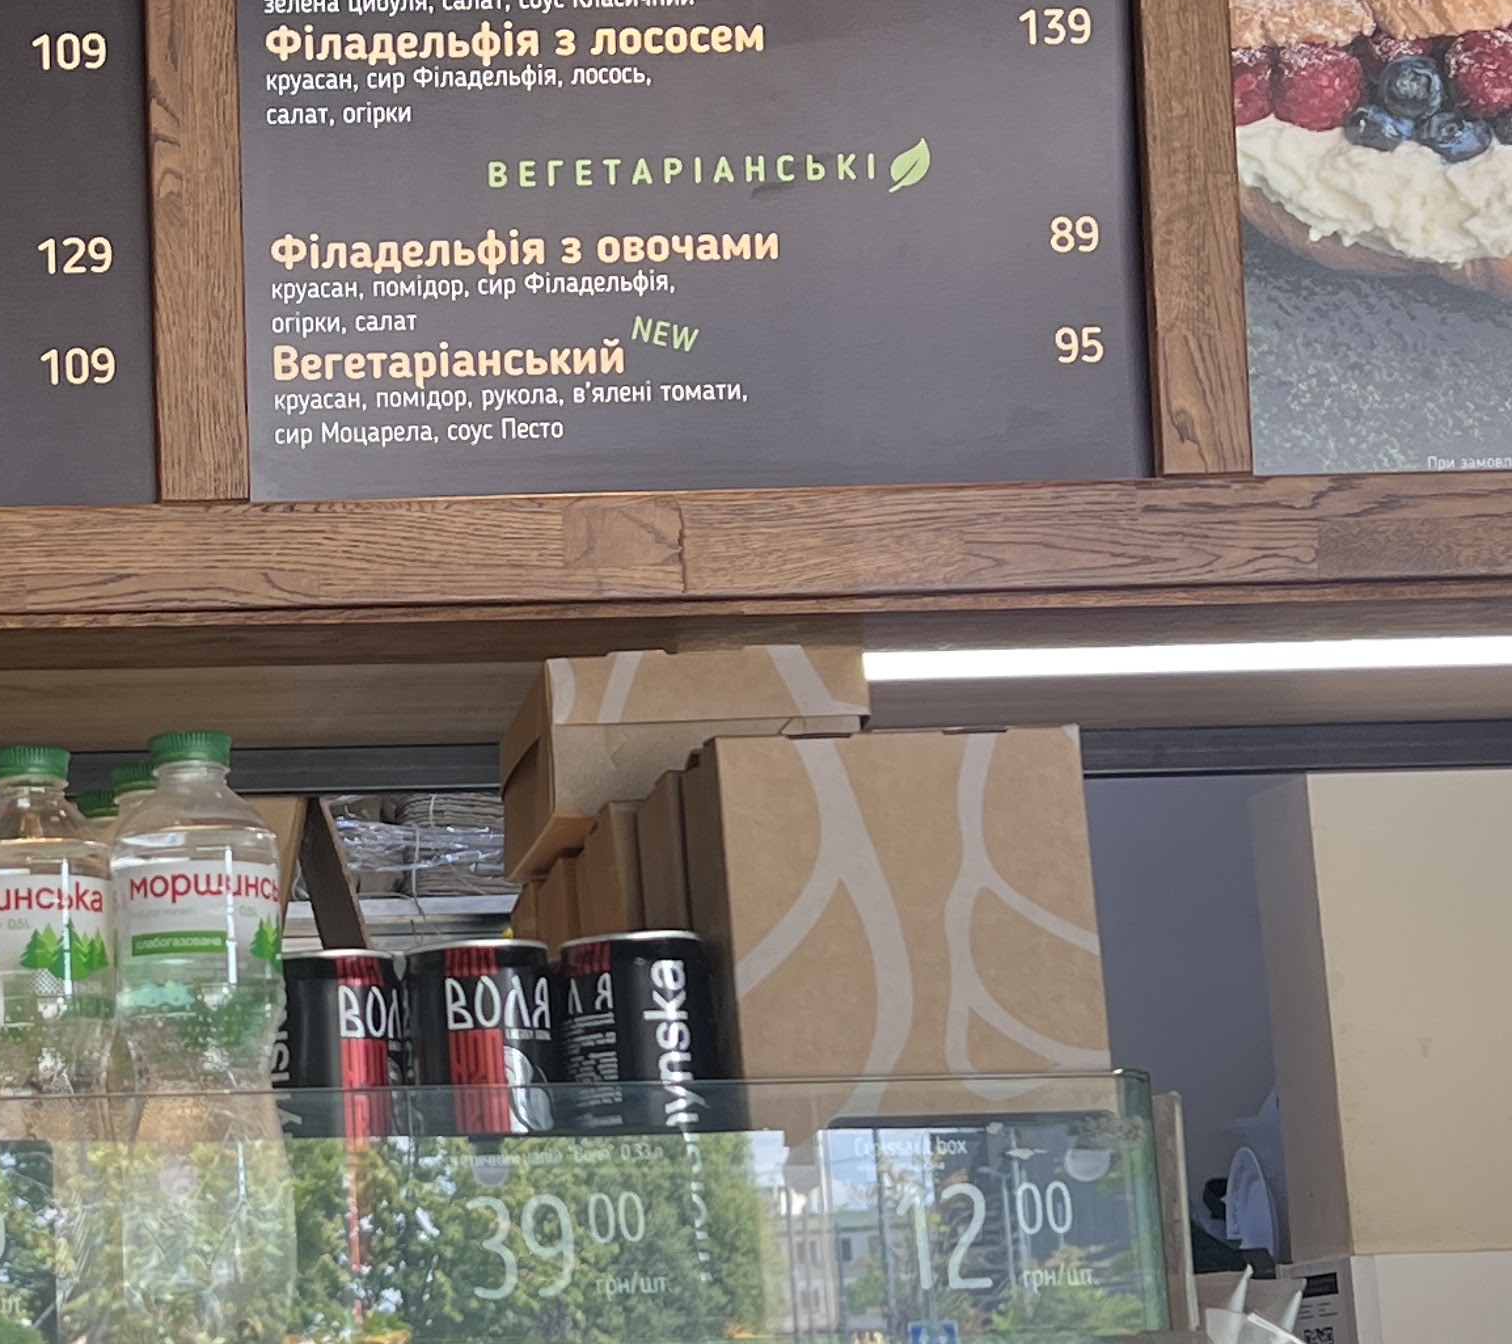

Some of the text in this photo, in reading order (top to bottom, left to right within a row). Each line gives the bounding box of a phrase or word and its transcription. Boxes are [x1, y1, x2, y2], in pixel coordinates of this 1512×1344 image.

[265, 20, 764, 68] Філадельфія з лососем
[1018, 7, 1092, 46] 139
[31, 32, 108, 71] 109
[487, 150, 877, 190] ВЕГЕТАРІАНСЬКІ
[270, 228, 779, 276] Філадельфія з овочами
[1050, 215, 1100, 253] 89
[37, 236, 114, 275] 129
[631, 315, 699, 353] NEW
[1055, 326, 1105, 364] 95
[40, 347, 116, 386] 109
[273, 338, 626, 387] Вегетаріанський
[445, 974, 552, 1031] ВОЛЯ
[937, 1136, 968, 1155] box
[589, 1191, 645, 1244] 00
[1017, 1181, 1073, 1235] 00
[466, 1193, 575, 1300] 39
[896, 1183, 993, 1289] 12
